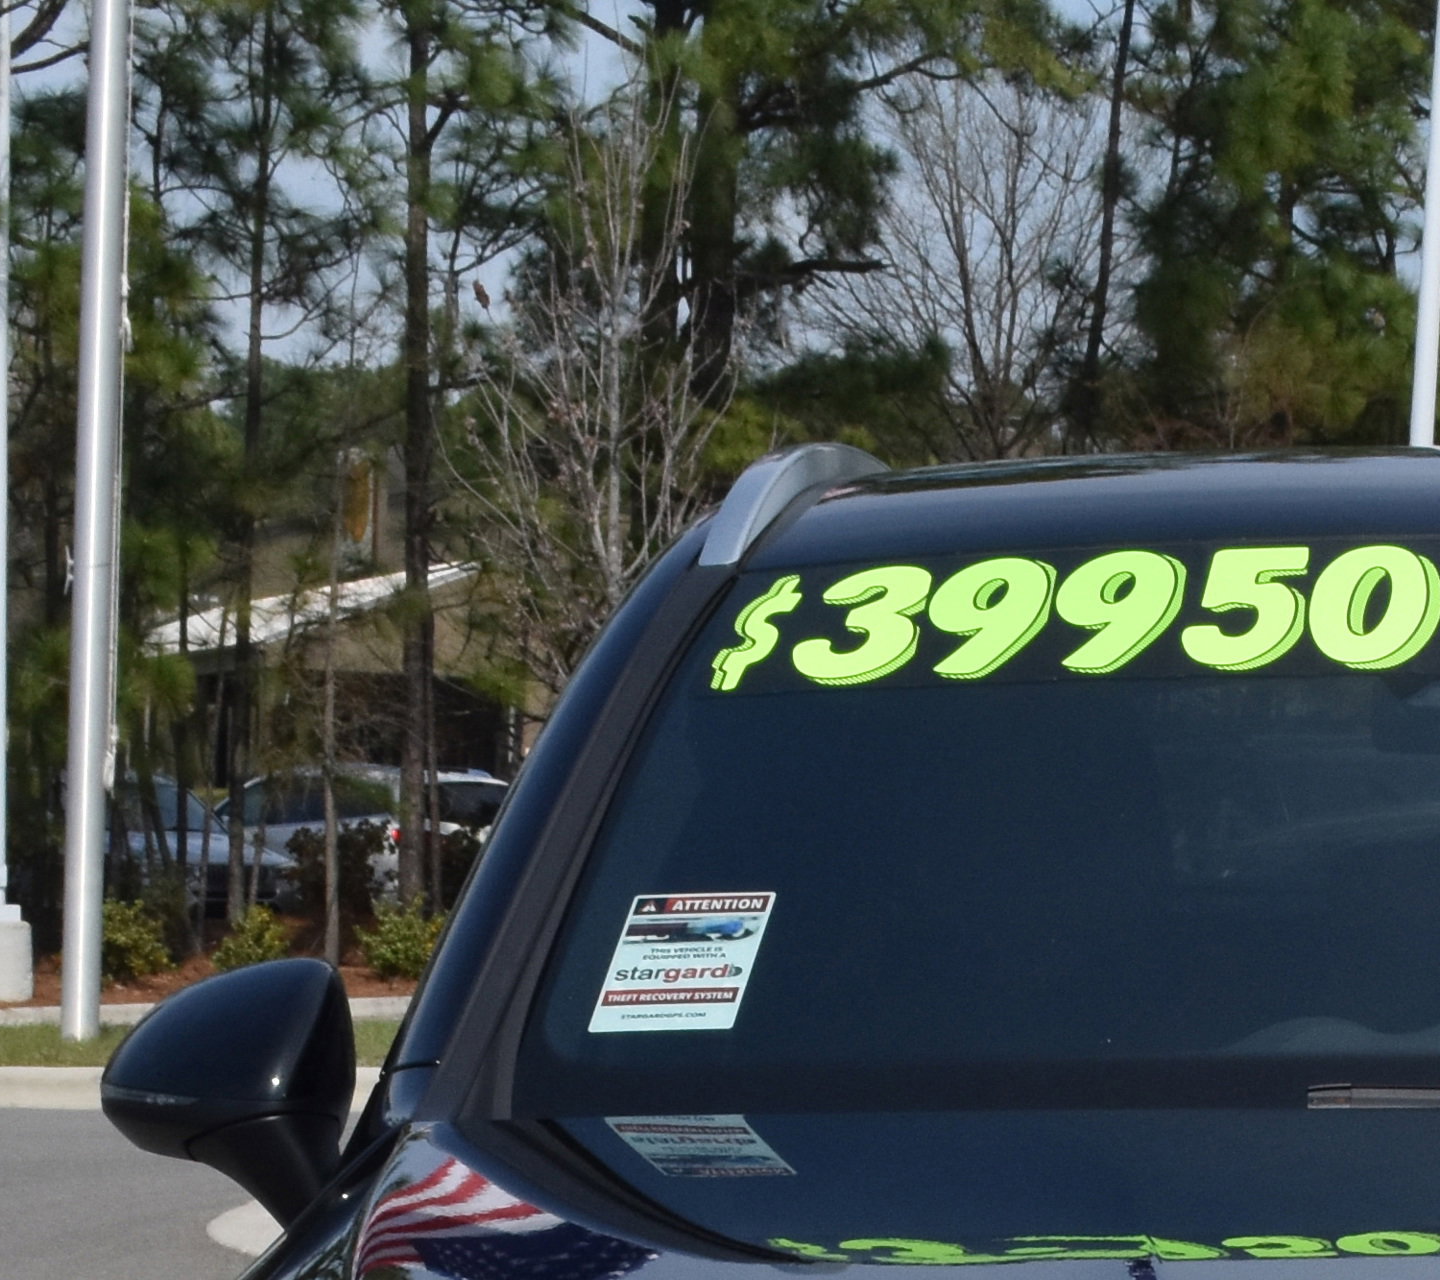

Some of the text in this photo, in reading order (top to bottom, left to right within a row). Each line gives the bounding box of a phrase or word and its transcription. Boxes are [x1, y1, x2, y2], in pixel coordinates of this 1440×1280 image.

[672, 898, 763, 911] ATTENTION
[615, 964, 729, 983] stargard
[607, 991, 733, 1002] THEFT RECOVERY SYSTEM
